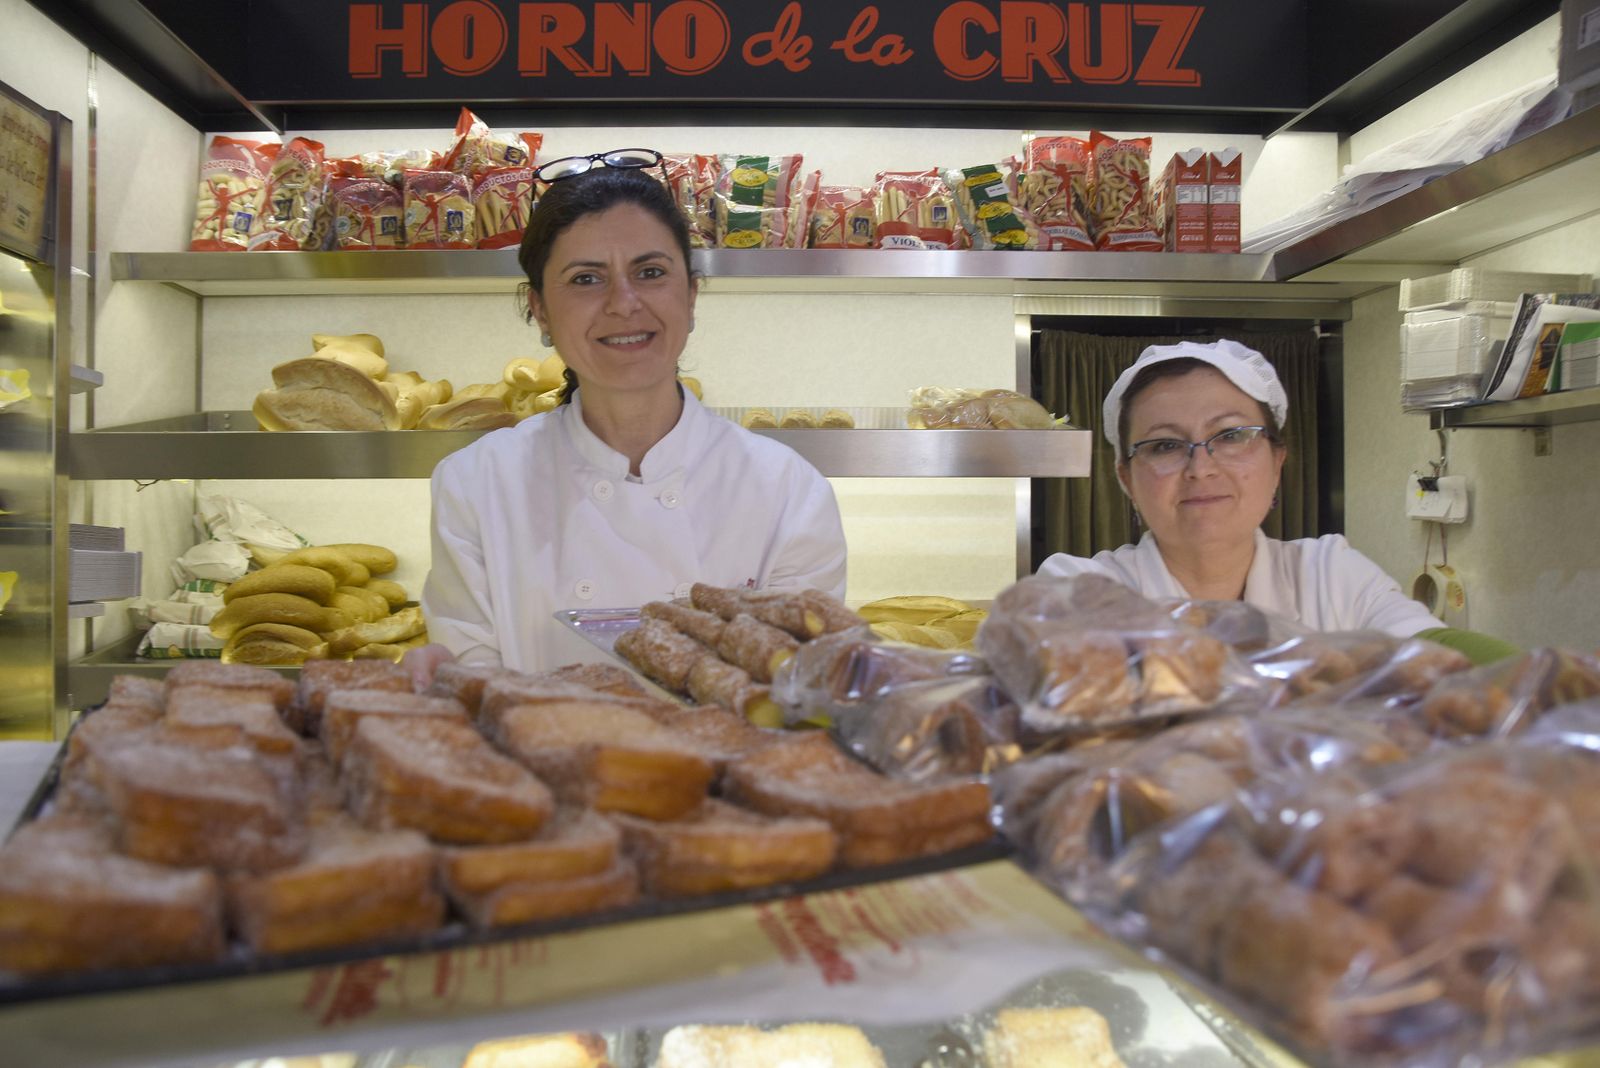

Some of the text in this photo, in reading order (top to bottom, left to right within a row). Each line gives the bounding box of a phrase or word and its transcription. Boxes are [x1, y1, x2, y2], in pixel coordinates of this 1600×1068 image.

[348, 0, 1205, 87] HORNO de la CRUZ
